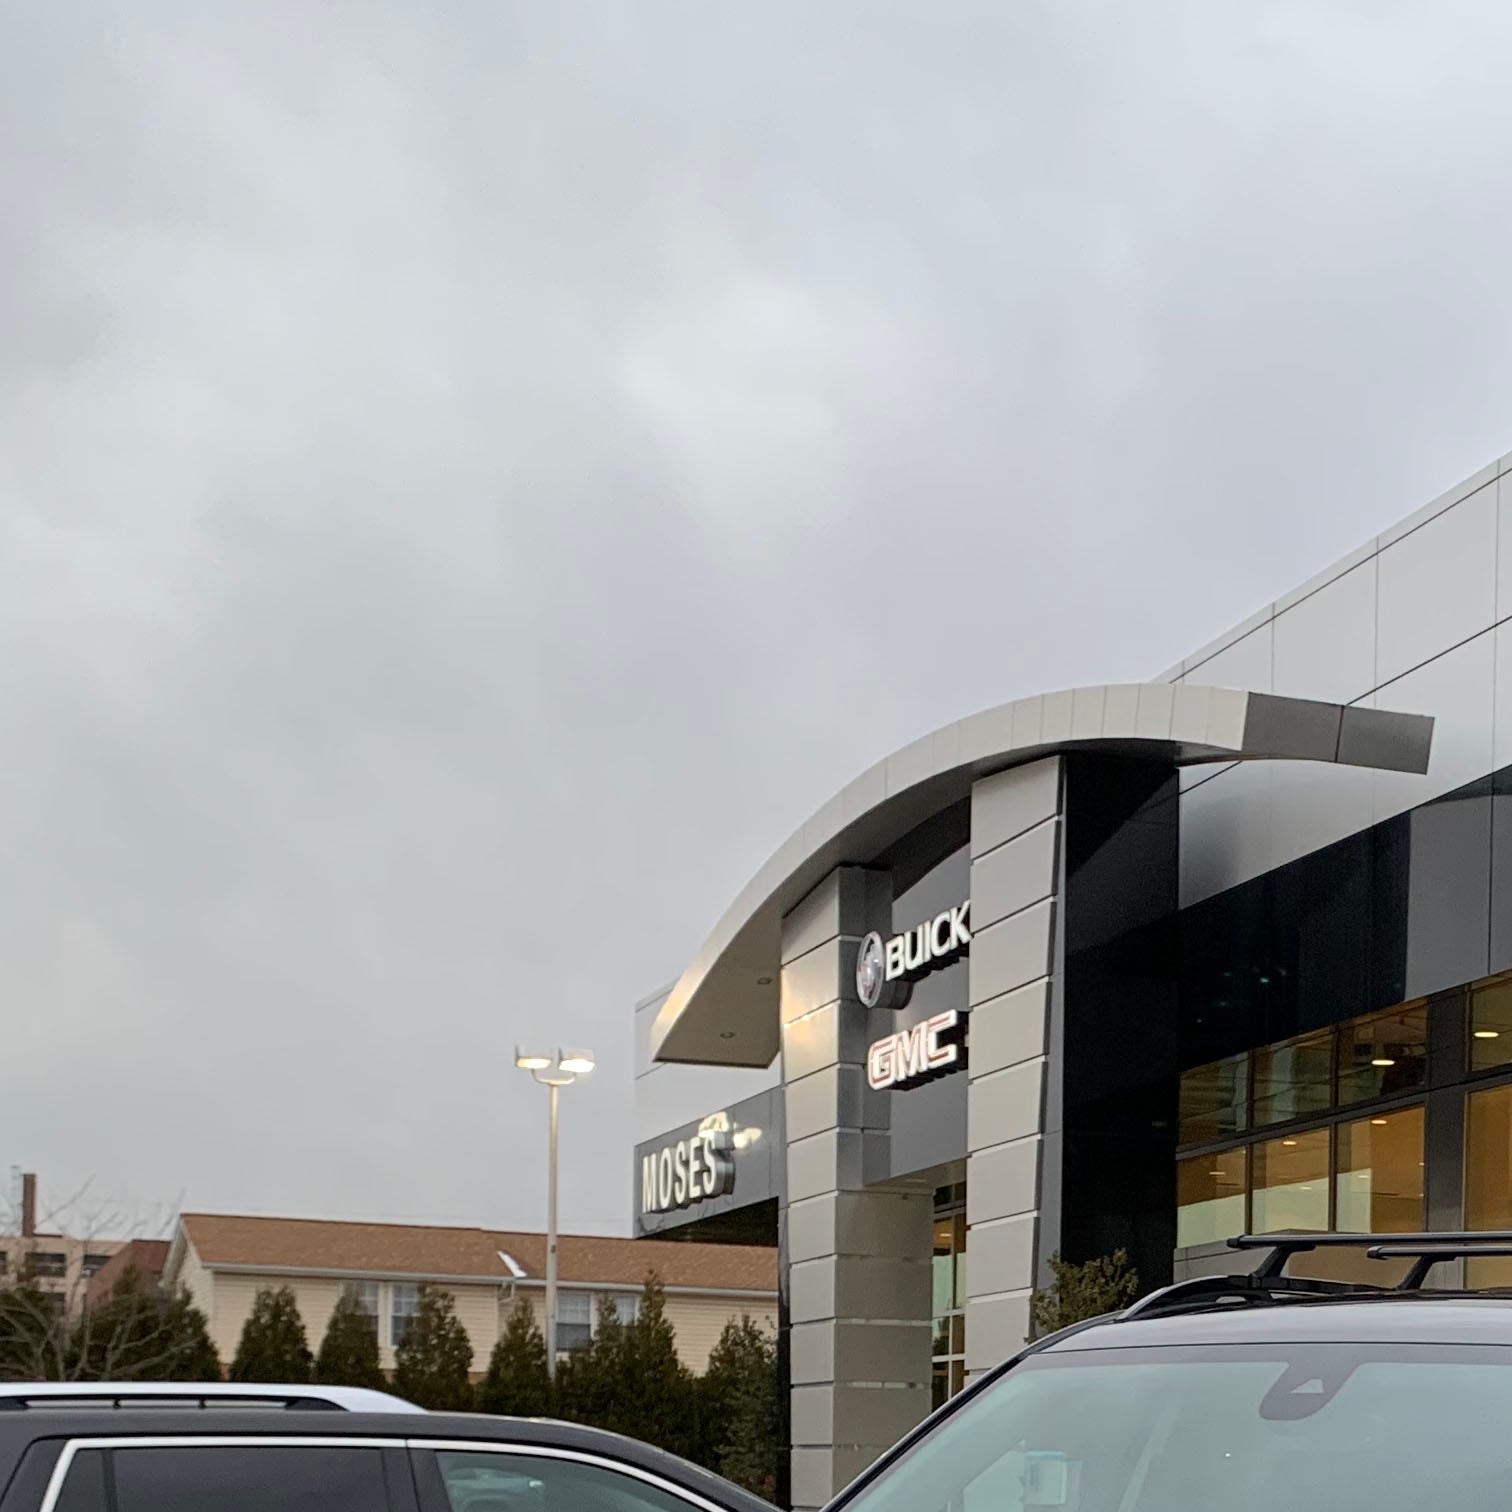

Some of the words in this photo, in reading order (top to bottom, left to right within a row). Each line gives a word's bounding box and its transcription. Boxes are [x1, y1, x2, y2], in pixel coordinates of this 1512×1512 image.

[886, 900, 973, 981] BUICK
[868, 1009, 958, 1090] GMC
[642, 1130, 717, 1214] MOSES
